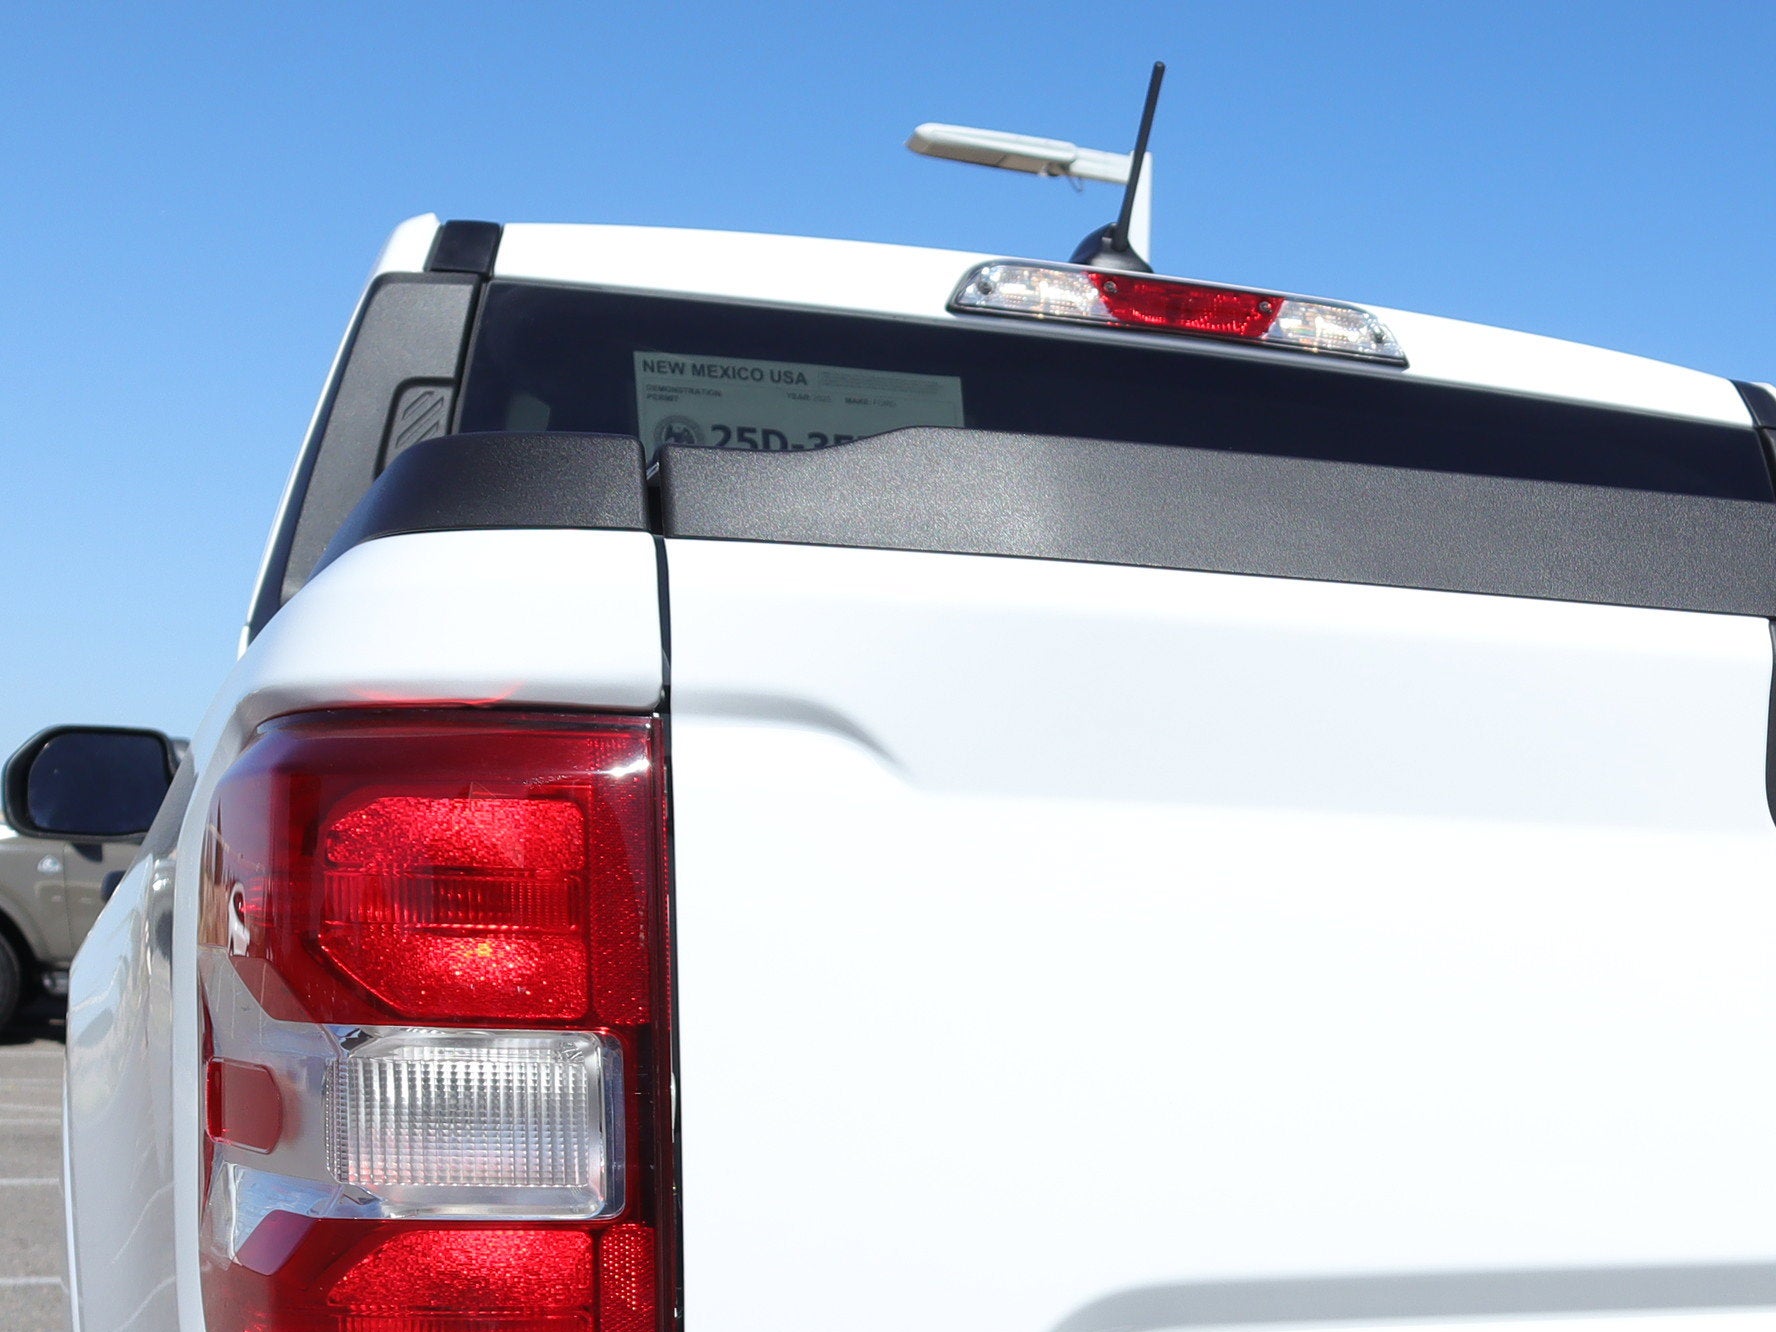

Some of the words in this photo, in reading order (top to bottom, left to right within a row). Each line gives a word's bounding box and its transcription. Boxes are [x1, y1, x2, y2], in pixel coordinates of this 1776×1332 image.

[643, 359, 686, 375] NEW
[691, 362, 764, 383] MEXICO
[770, 369, 808, 386] USA
